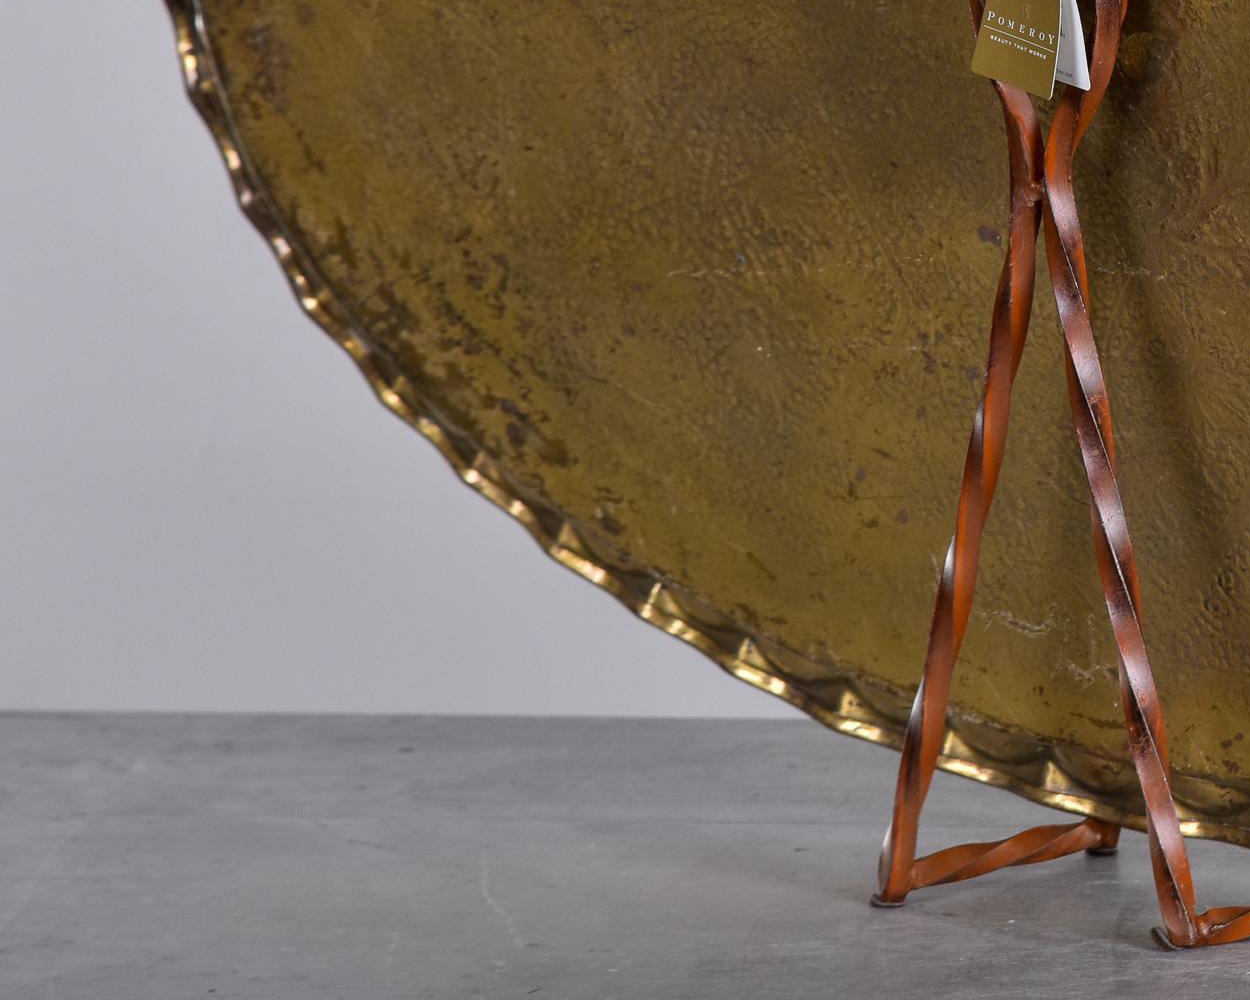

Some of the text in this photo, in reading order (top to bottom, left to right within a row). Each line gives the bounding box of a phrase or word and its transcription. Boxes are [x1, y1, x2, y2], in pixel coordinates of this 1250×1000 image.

[987, 11, 1055, 45] POMEROY
[990, 35, 1047, 60] BEAUTY THAT WORKS
